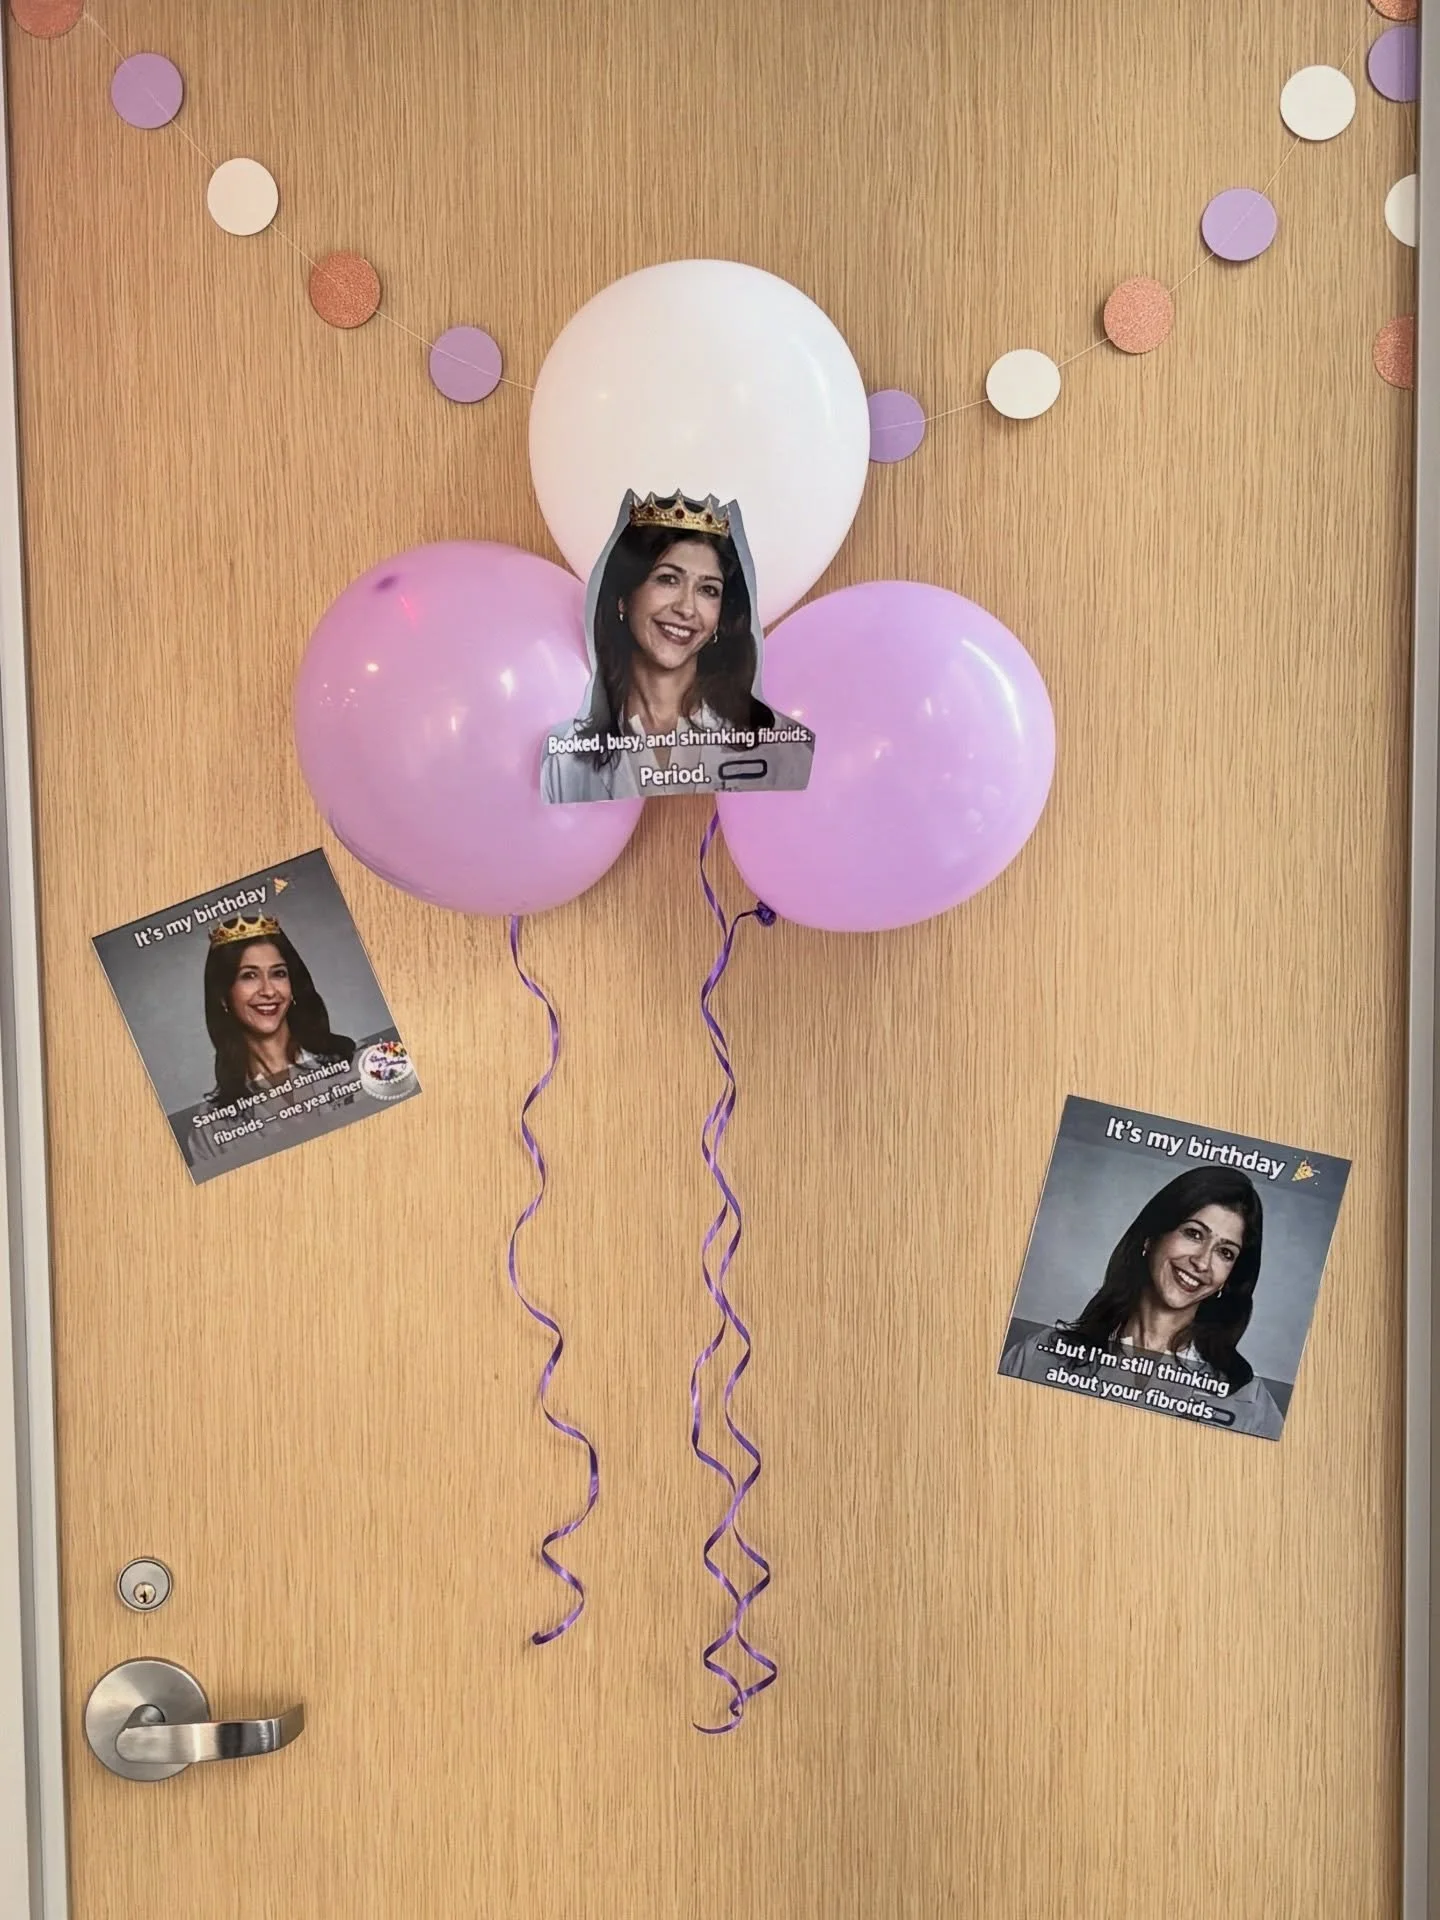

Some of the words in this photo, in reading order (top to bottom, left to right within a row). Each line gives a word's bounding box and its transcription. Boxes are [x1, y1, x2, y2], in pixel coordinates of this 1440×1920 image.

[548, 736, 604, 754] Booked,
[606, 733, 645, 753] busy,
[646, 730, 676, 748] and
[679, 728, 755, 747] shrinking
[757, 726, 812, 743] fibroids.
[640, 764, 711, 786] Period.
[134, 927, 164, 947] It’s
[166, 916, 192, 936] my
[194, 885, 266, 923] birthday
[192, 1103, 237, 1128] Saving
[236, 1090, 268, 1110] lives
[269, 1080, 293, 1098] and
[293, 1059, 350, 1088] shrinking
[213, 1117, 264, 1145] fibroids
[279, 1102, 303, 1119] one
[302, 1091, 332, 1113] year
[1106, 1117, 1142, 1144] It’s
[1147, 1131, 1184, 1158] my
[1187, 1136, 1286, 1181] birthday
[1046, 1367, 1099, 1392] about
[1100, 1381, 1143, 1398] your
[1088, 1346, 1117, 1368] I’m
[1120, 1357, 1154, 1376] still
[1157, 1363, 1230, 1398] thinking
